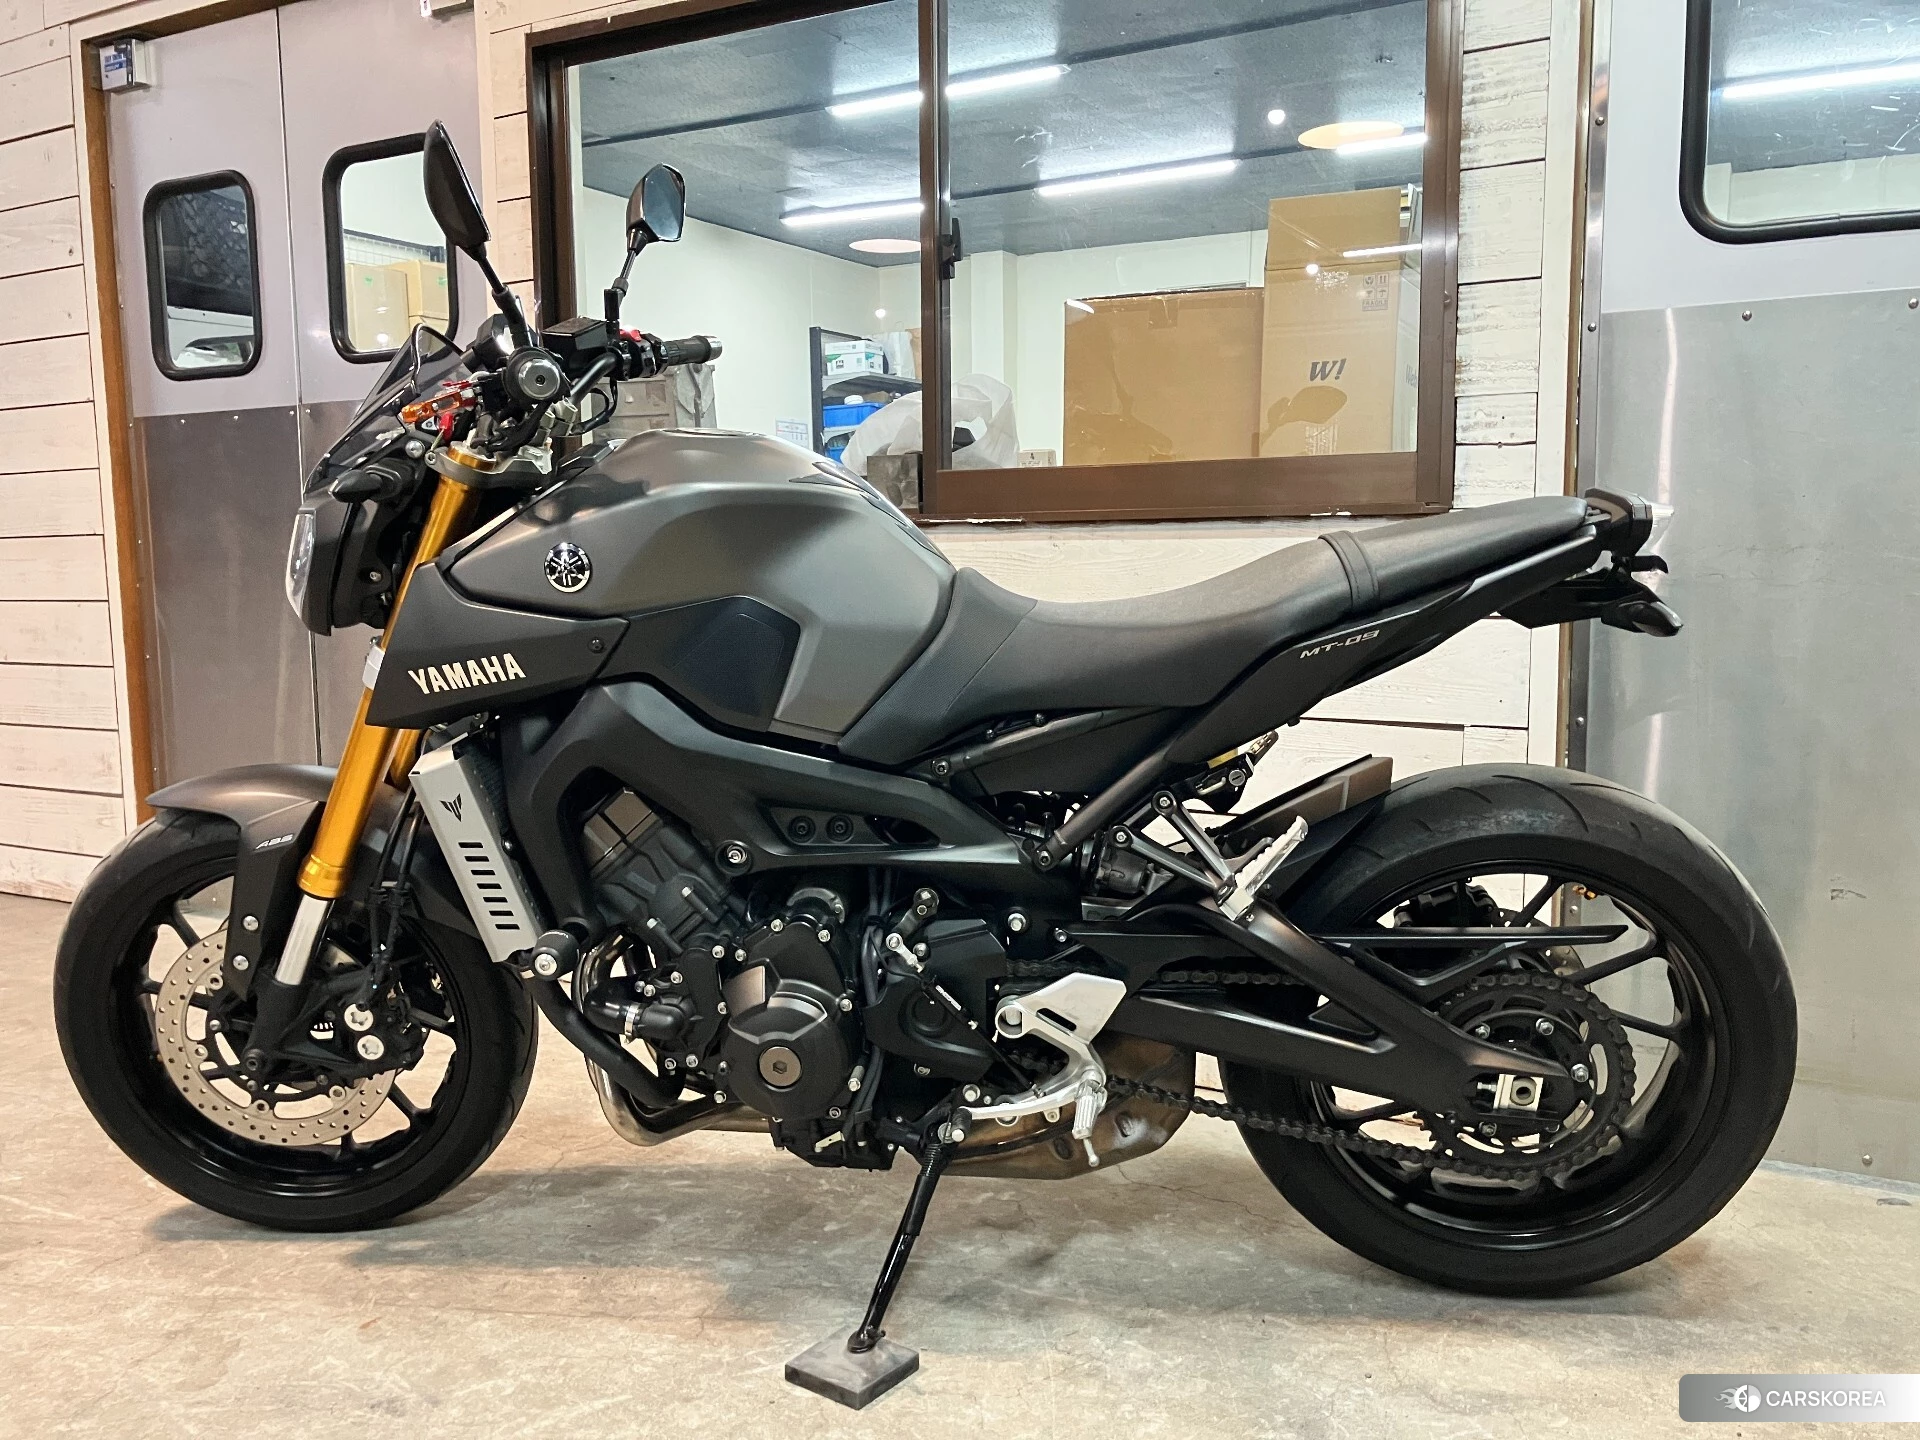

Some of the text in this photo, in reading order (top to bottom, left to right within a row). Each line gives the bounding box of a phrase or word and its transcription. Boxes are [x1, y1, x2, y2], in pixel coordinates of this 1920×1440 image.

[1309, 358, 1347, 382] W!
[1300, 630, 1380, 659] MT-09
[407, 652, 527, 695] YAMAHA
